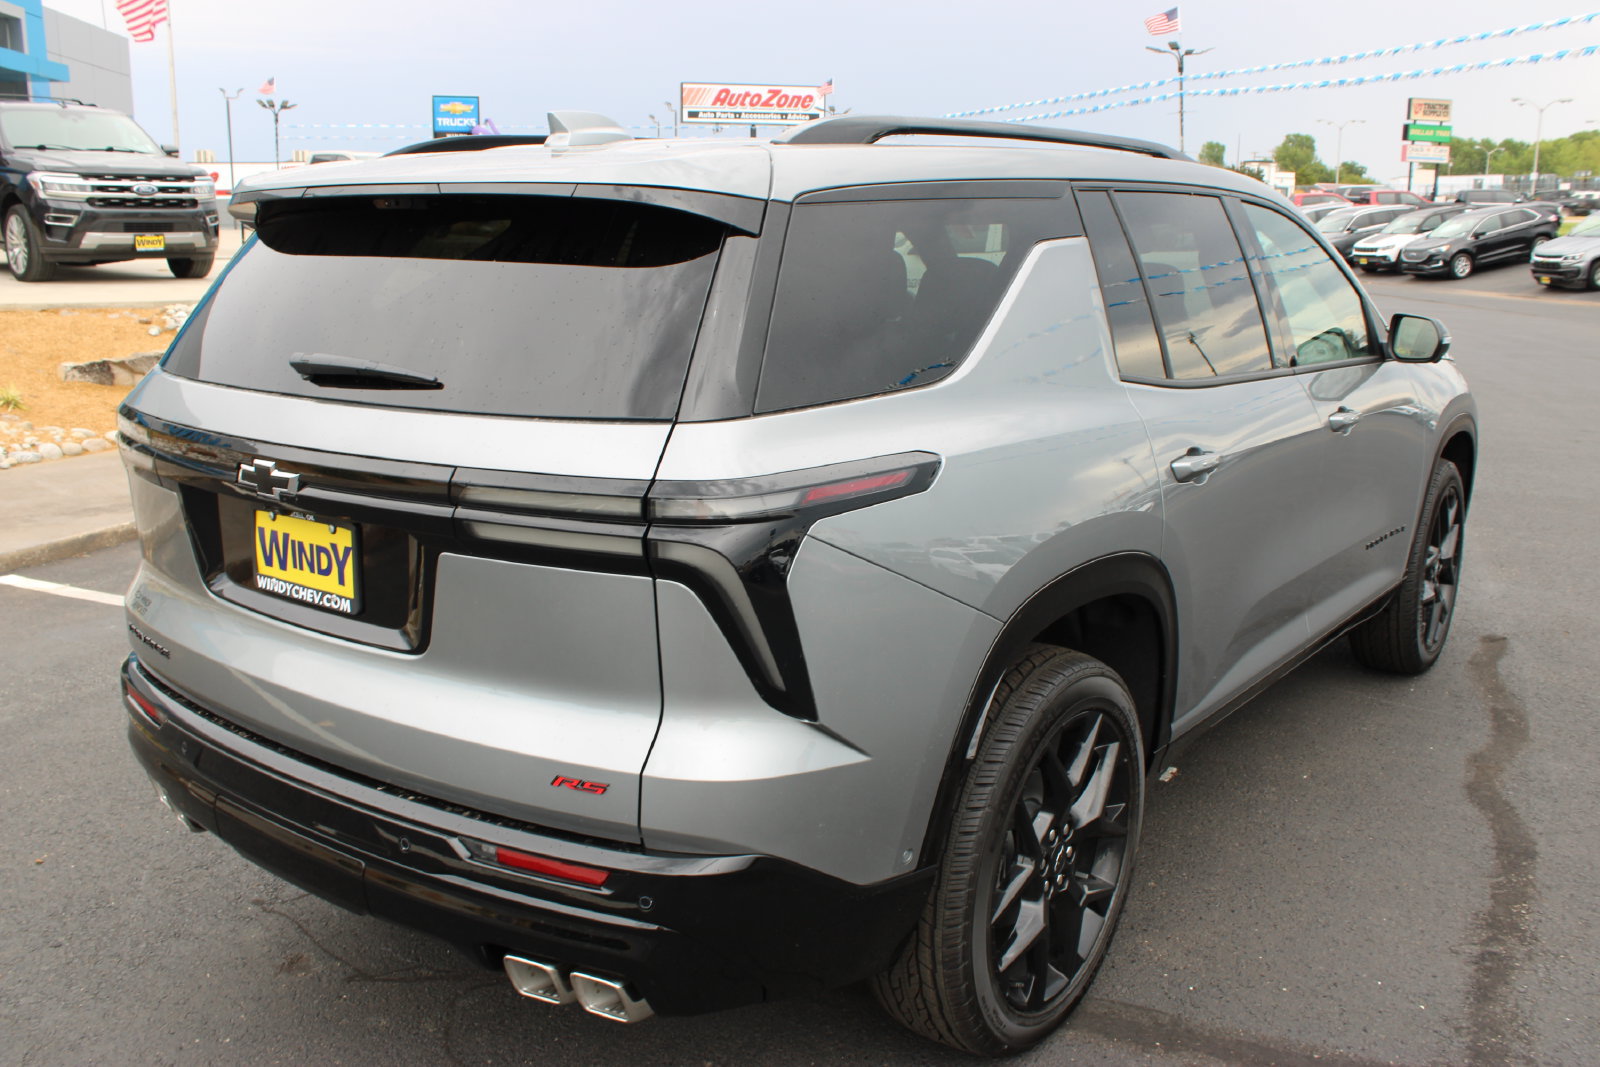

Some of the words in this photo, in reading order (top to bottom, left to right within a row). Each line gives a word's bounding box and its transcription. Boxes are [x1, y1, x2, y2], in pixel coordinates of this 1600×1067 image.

[711, 88, 815, 109] AutoZone
[437, 117, 476, 127] TRUCKS
[698, 111, 715, 119] Auto
[741, 112, 782, 120] Accessories
[787, 113, 810, 121] Advice
[257, 527, 353, 587] WINDY
[256, 574, 352, 613] WINDYCHEV.COM
[550, 775, 610, 795] RS
